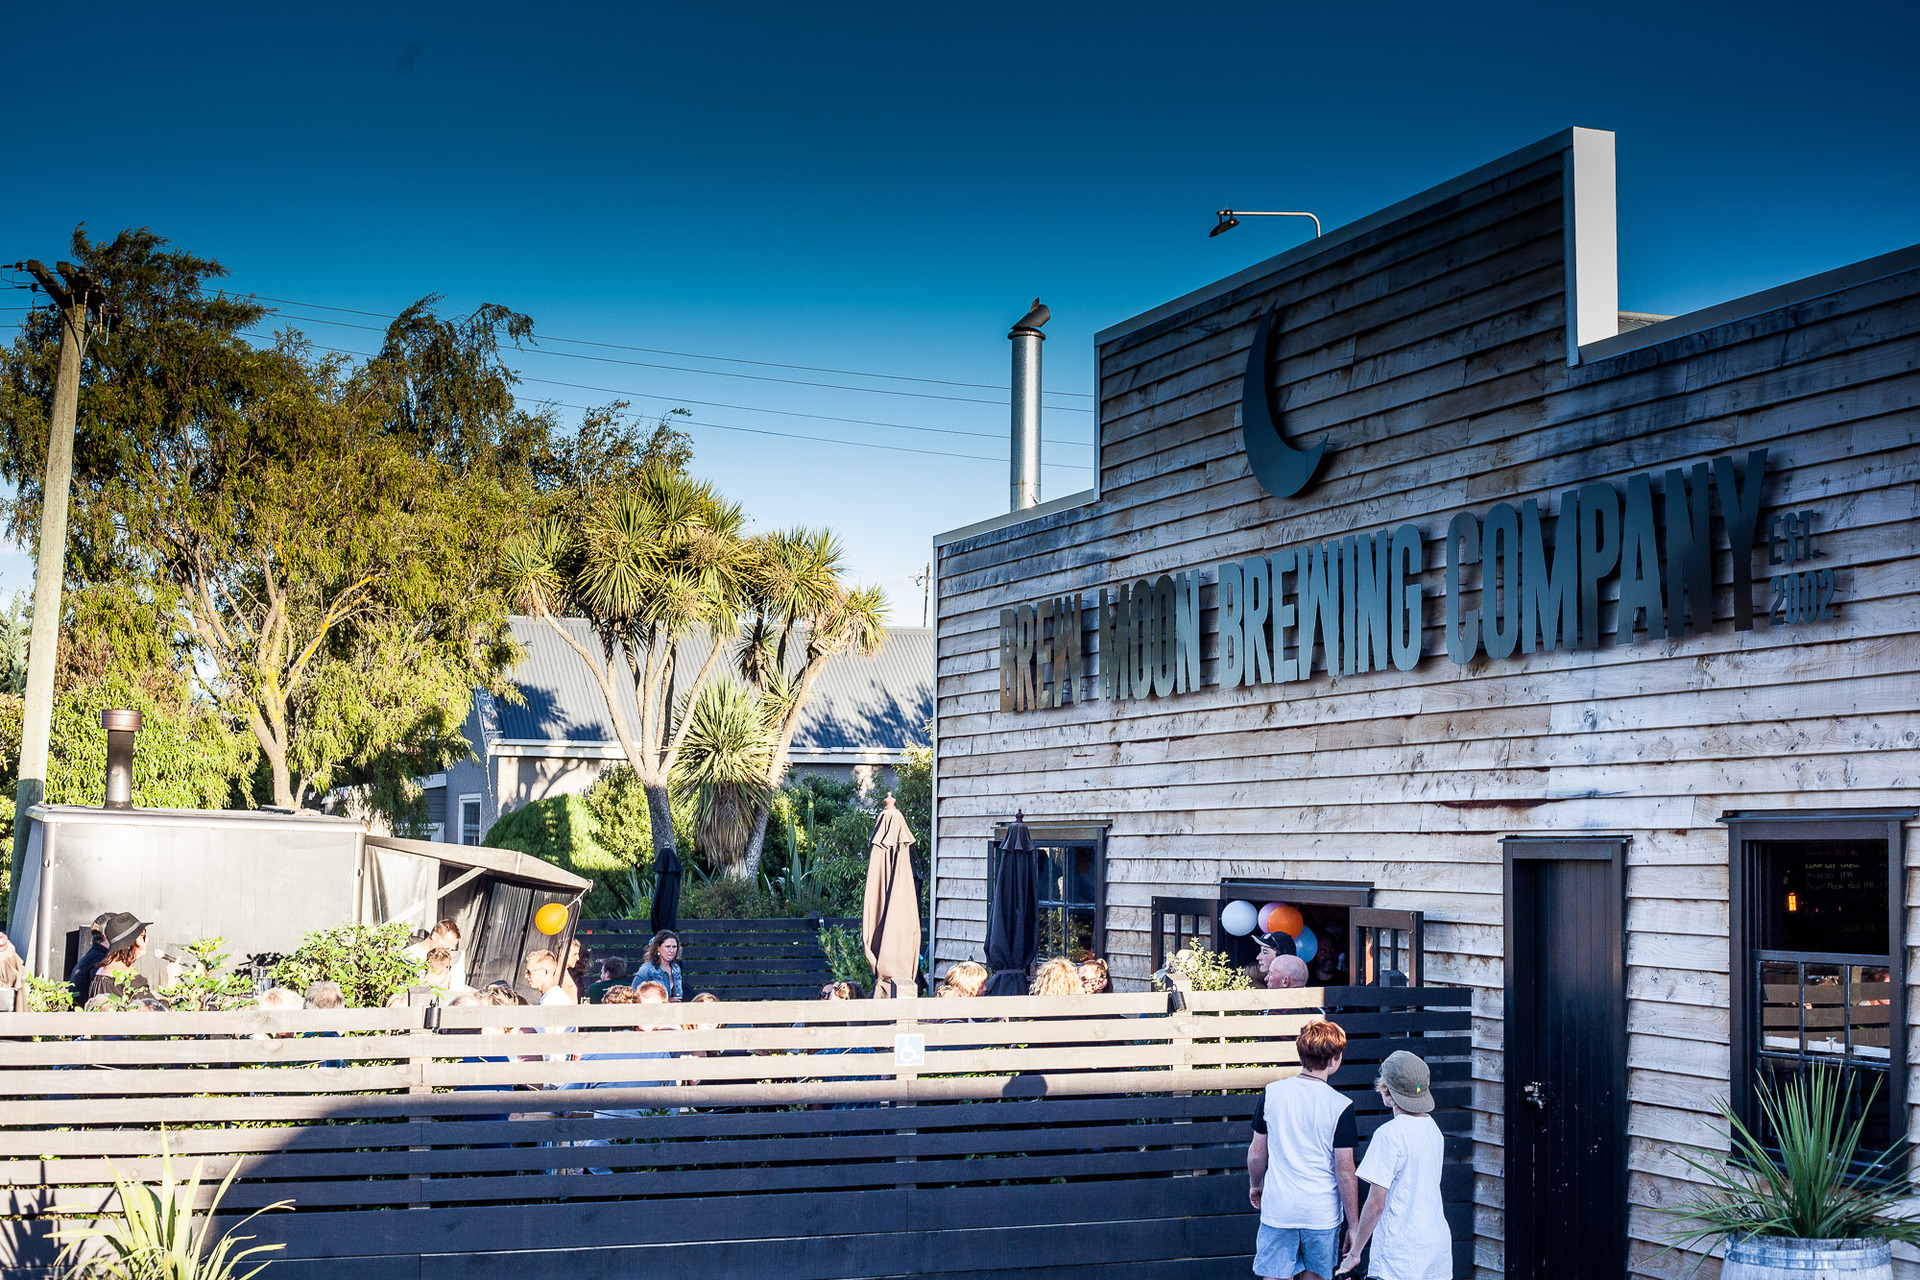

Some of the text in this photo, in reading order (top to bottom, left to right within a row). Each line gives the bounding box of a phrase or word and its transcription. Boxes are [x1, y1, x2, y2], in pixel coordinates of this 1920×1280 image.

[1768, 508, 1821, 566] EST.
[1000, 447, 1769, 713] BREW MOON BREWING COMPANY
[1769, 568, 1835, 626] 2002
